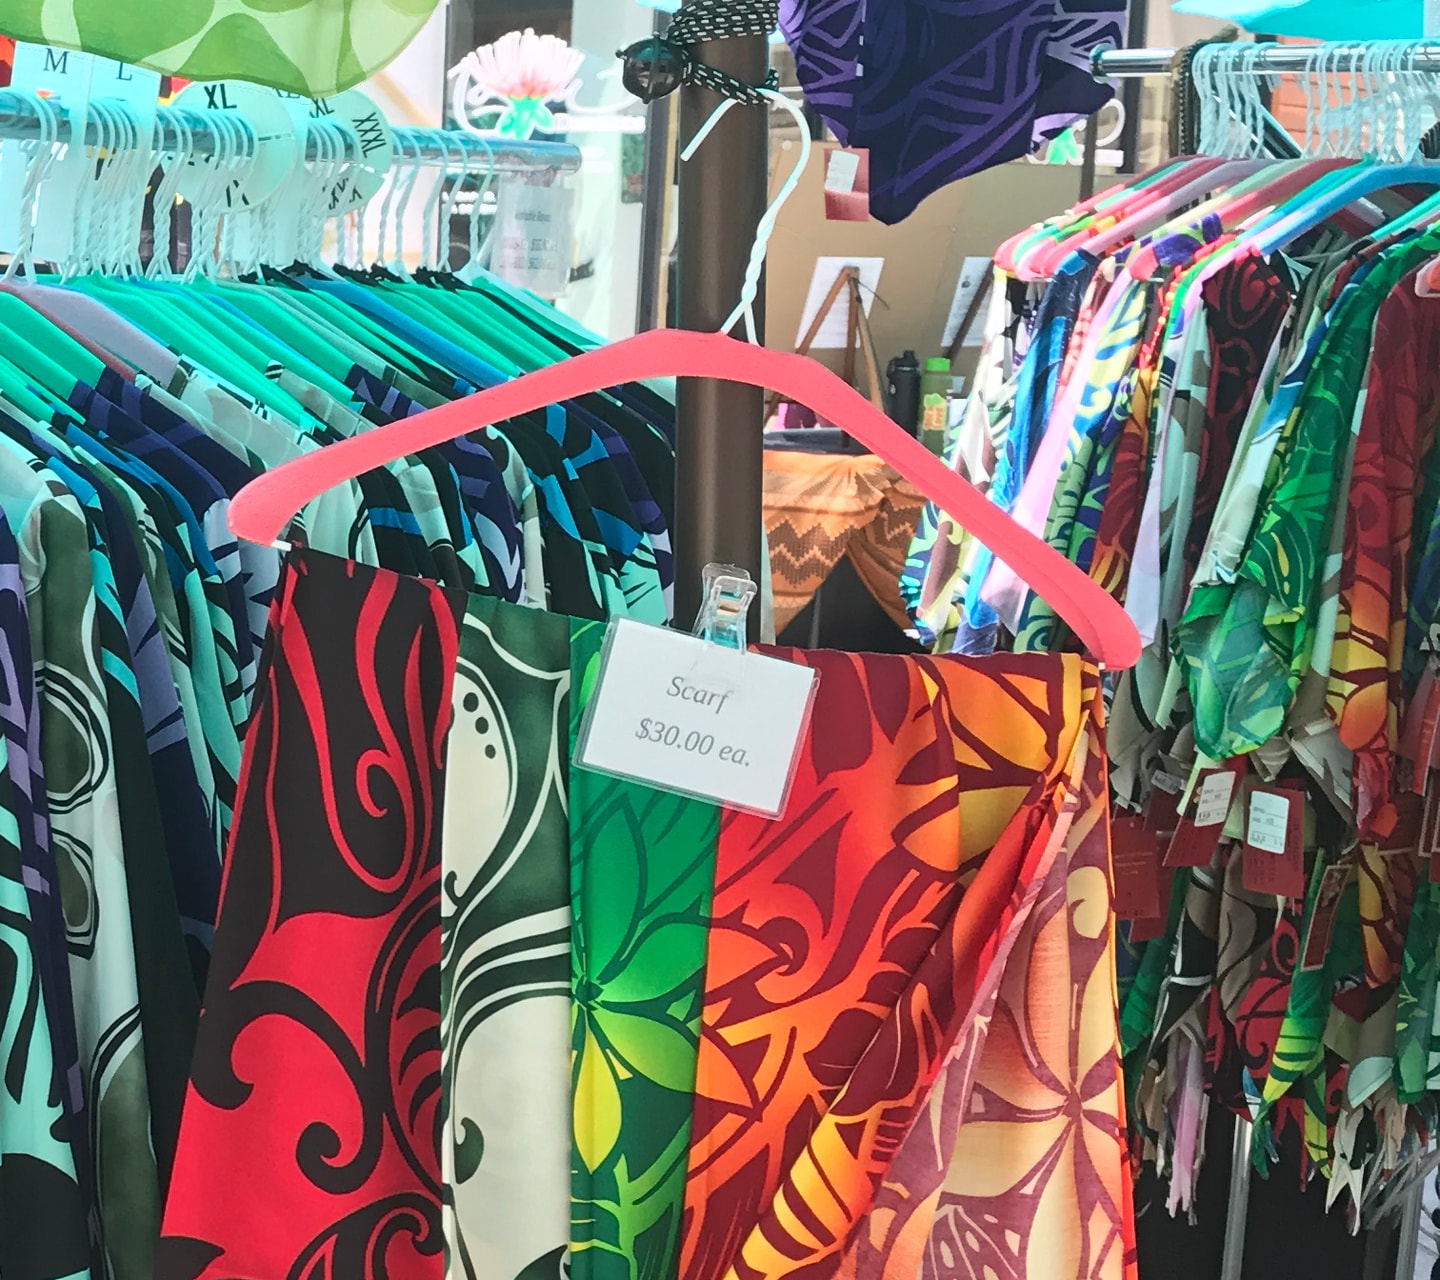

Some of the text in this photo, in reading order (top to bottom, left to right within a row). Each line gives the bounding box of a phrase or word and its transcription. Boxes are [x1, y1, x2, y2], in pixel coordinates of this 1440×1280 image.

[42, 48, 70, 76] M
[115, 61, 134, 82] L
[204, 83, 238, 110] XL
[351, 111, 388, 159] XXXL
[665, 675, 735, 715] Scarf
[635, 717, 750, 767] $30.00 ea.
